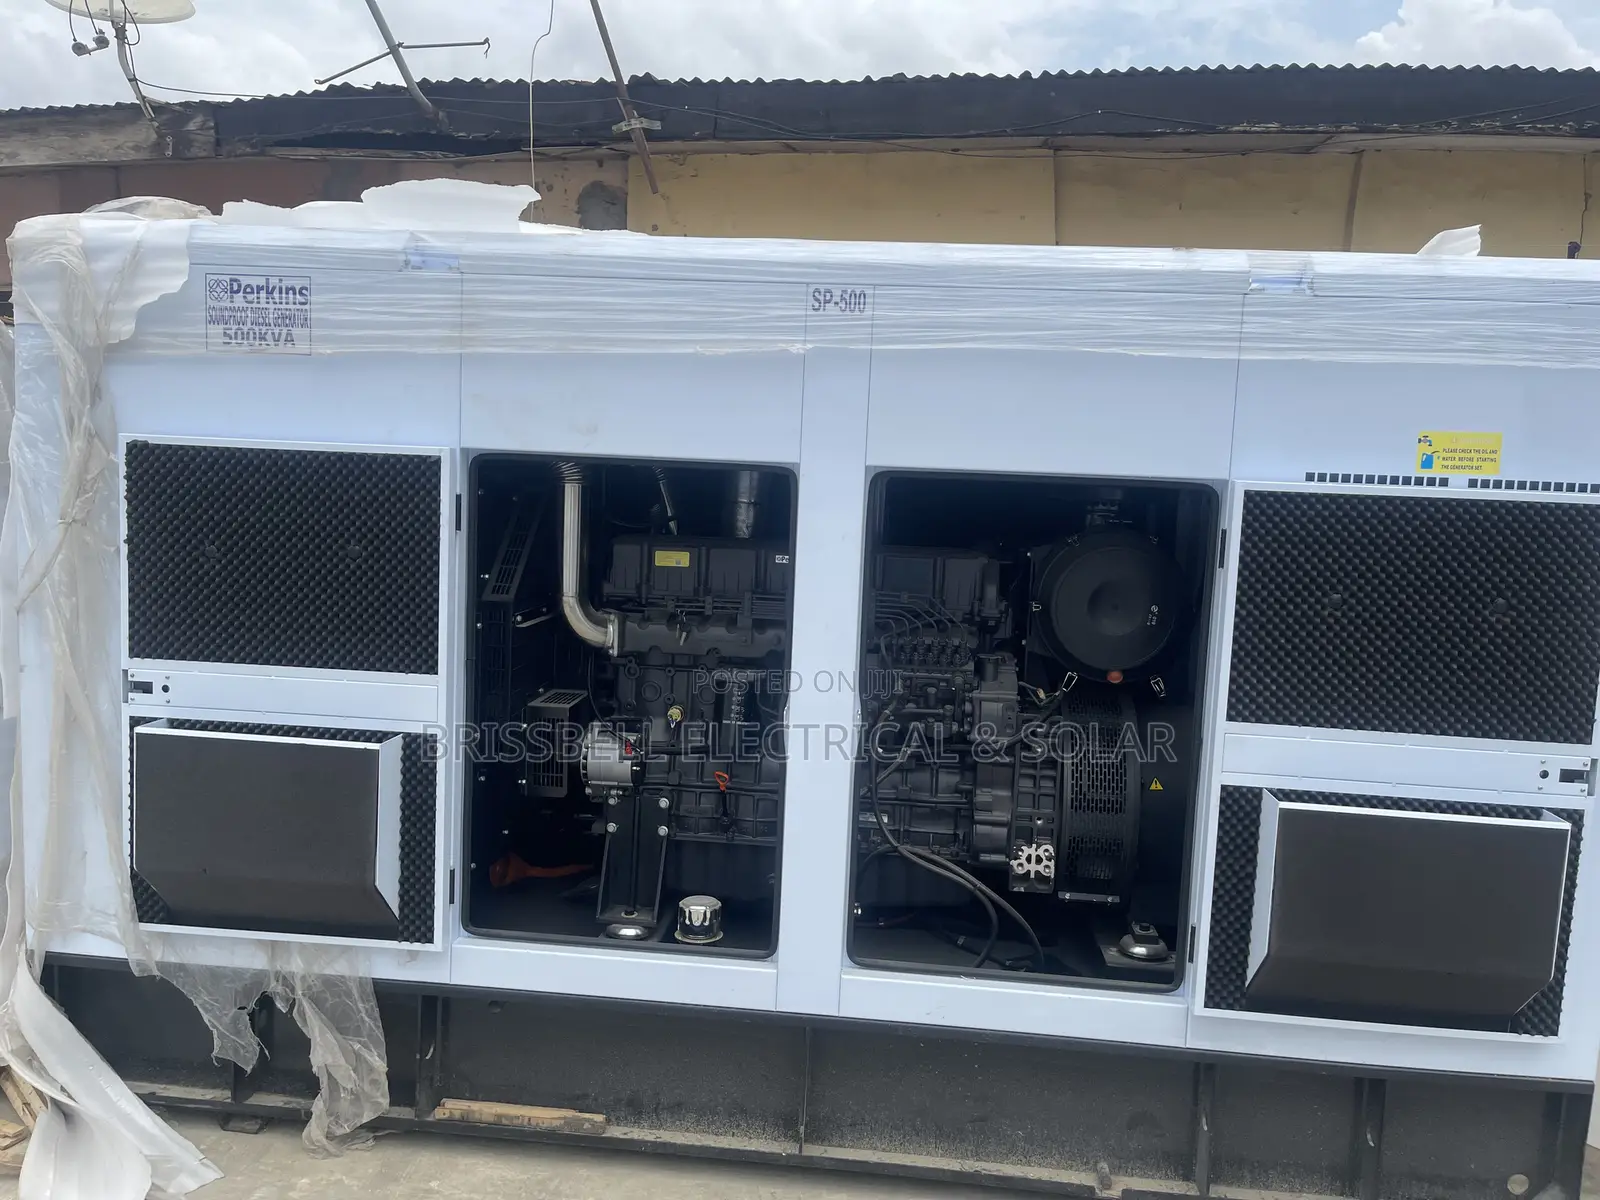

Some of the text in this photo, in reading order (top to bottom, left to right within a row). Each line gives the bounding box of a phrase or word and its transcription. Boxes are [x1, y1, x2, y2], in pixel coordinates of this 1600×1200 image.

[229, 277, 309, 305] Perkins
[812, 288, 866, 313] SP-500
[208, 305, 309, 328] SOUNDPROOF DIESEL GENERATOR
[223, 327, 295, 346] 500KVA
